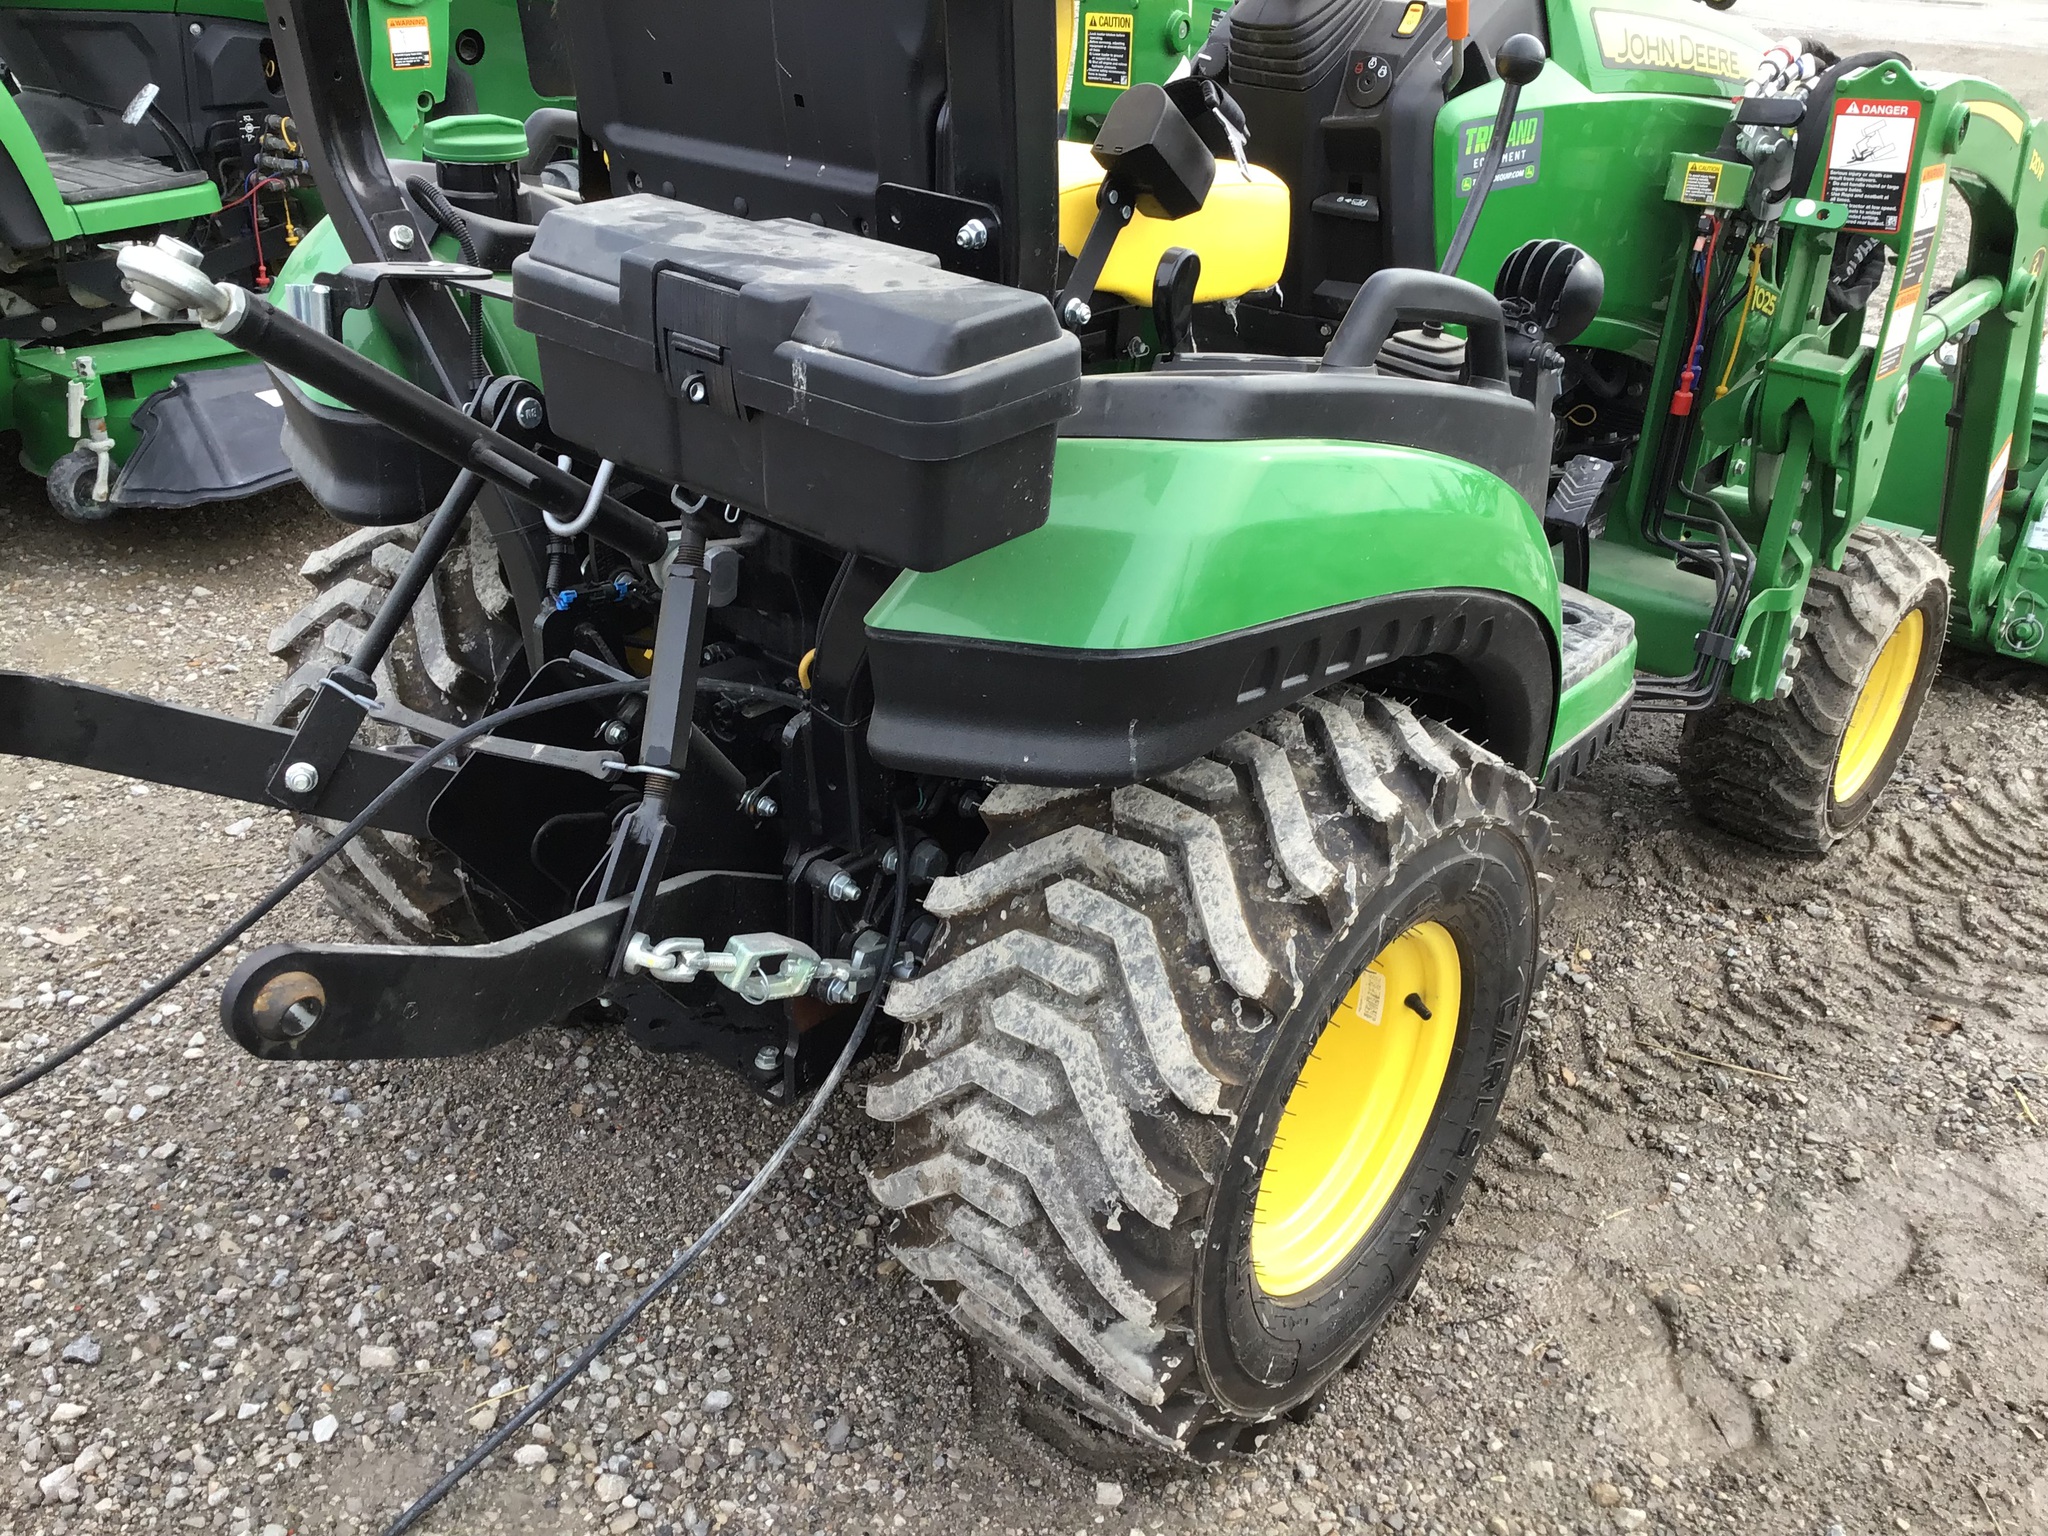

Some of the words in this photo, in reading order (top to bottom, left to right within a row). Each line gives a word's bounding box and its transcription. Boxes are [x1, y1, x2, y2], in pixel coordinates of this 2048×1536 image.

[1099, 16, 1131, 28] CAUTION
[1617, 27, 1675, 63] JOHN
[1680, 35, 1740, 75] DEERE
[1862, 104, 1908, 115] DANGER
[1465, 117, 1538, 155] TRIAND
[1751, 285, 1777, 316] 1025
